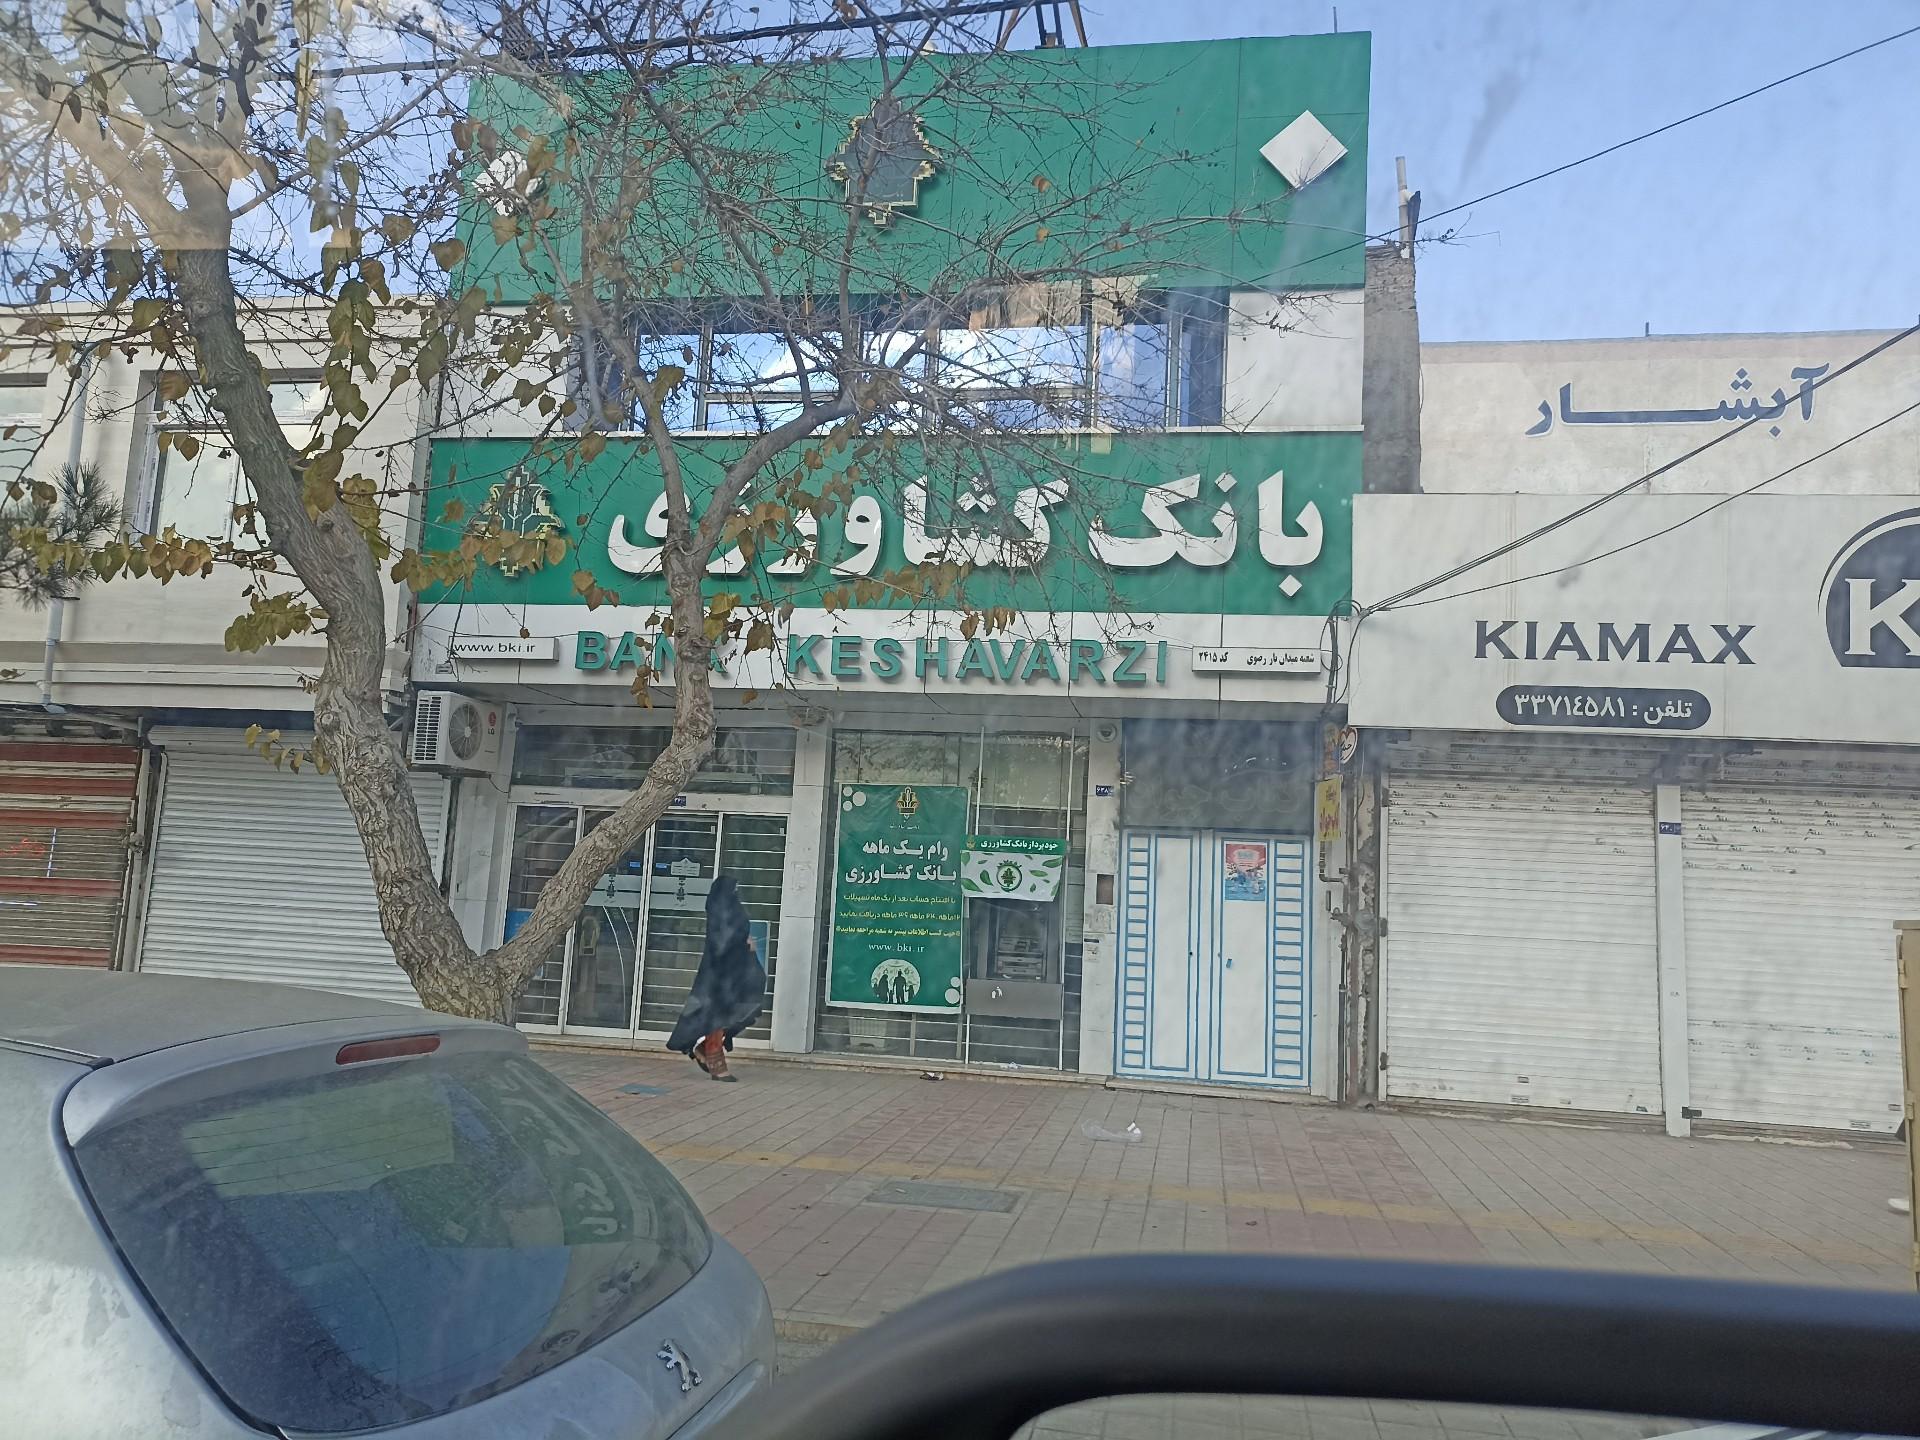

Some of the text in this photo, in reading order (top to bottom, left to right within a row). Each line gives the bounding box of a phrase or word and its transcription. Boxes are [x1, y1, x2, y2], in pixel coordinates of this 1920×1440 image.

[1525, 363, 1830, 439] آبشار
[1087, 470, 1324, 598] بانک
[454, 642, 536, 653] www.bki.ir
[1474, 620, 1757, 666] KIAMAX
[787, 632, 1168, 684] KESHAVARZI
[1219, 651, 1229, 663] کد
[1643, 699, 1693, 725] تلفن
[862, 838, 949, 861] وام یک ماهه
[845, 863, 957, 886] بانک کشاورزی
